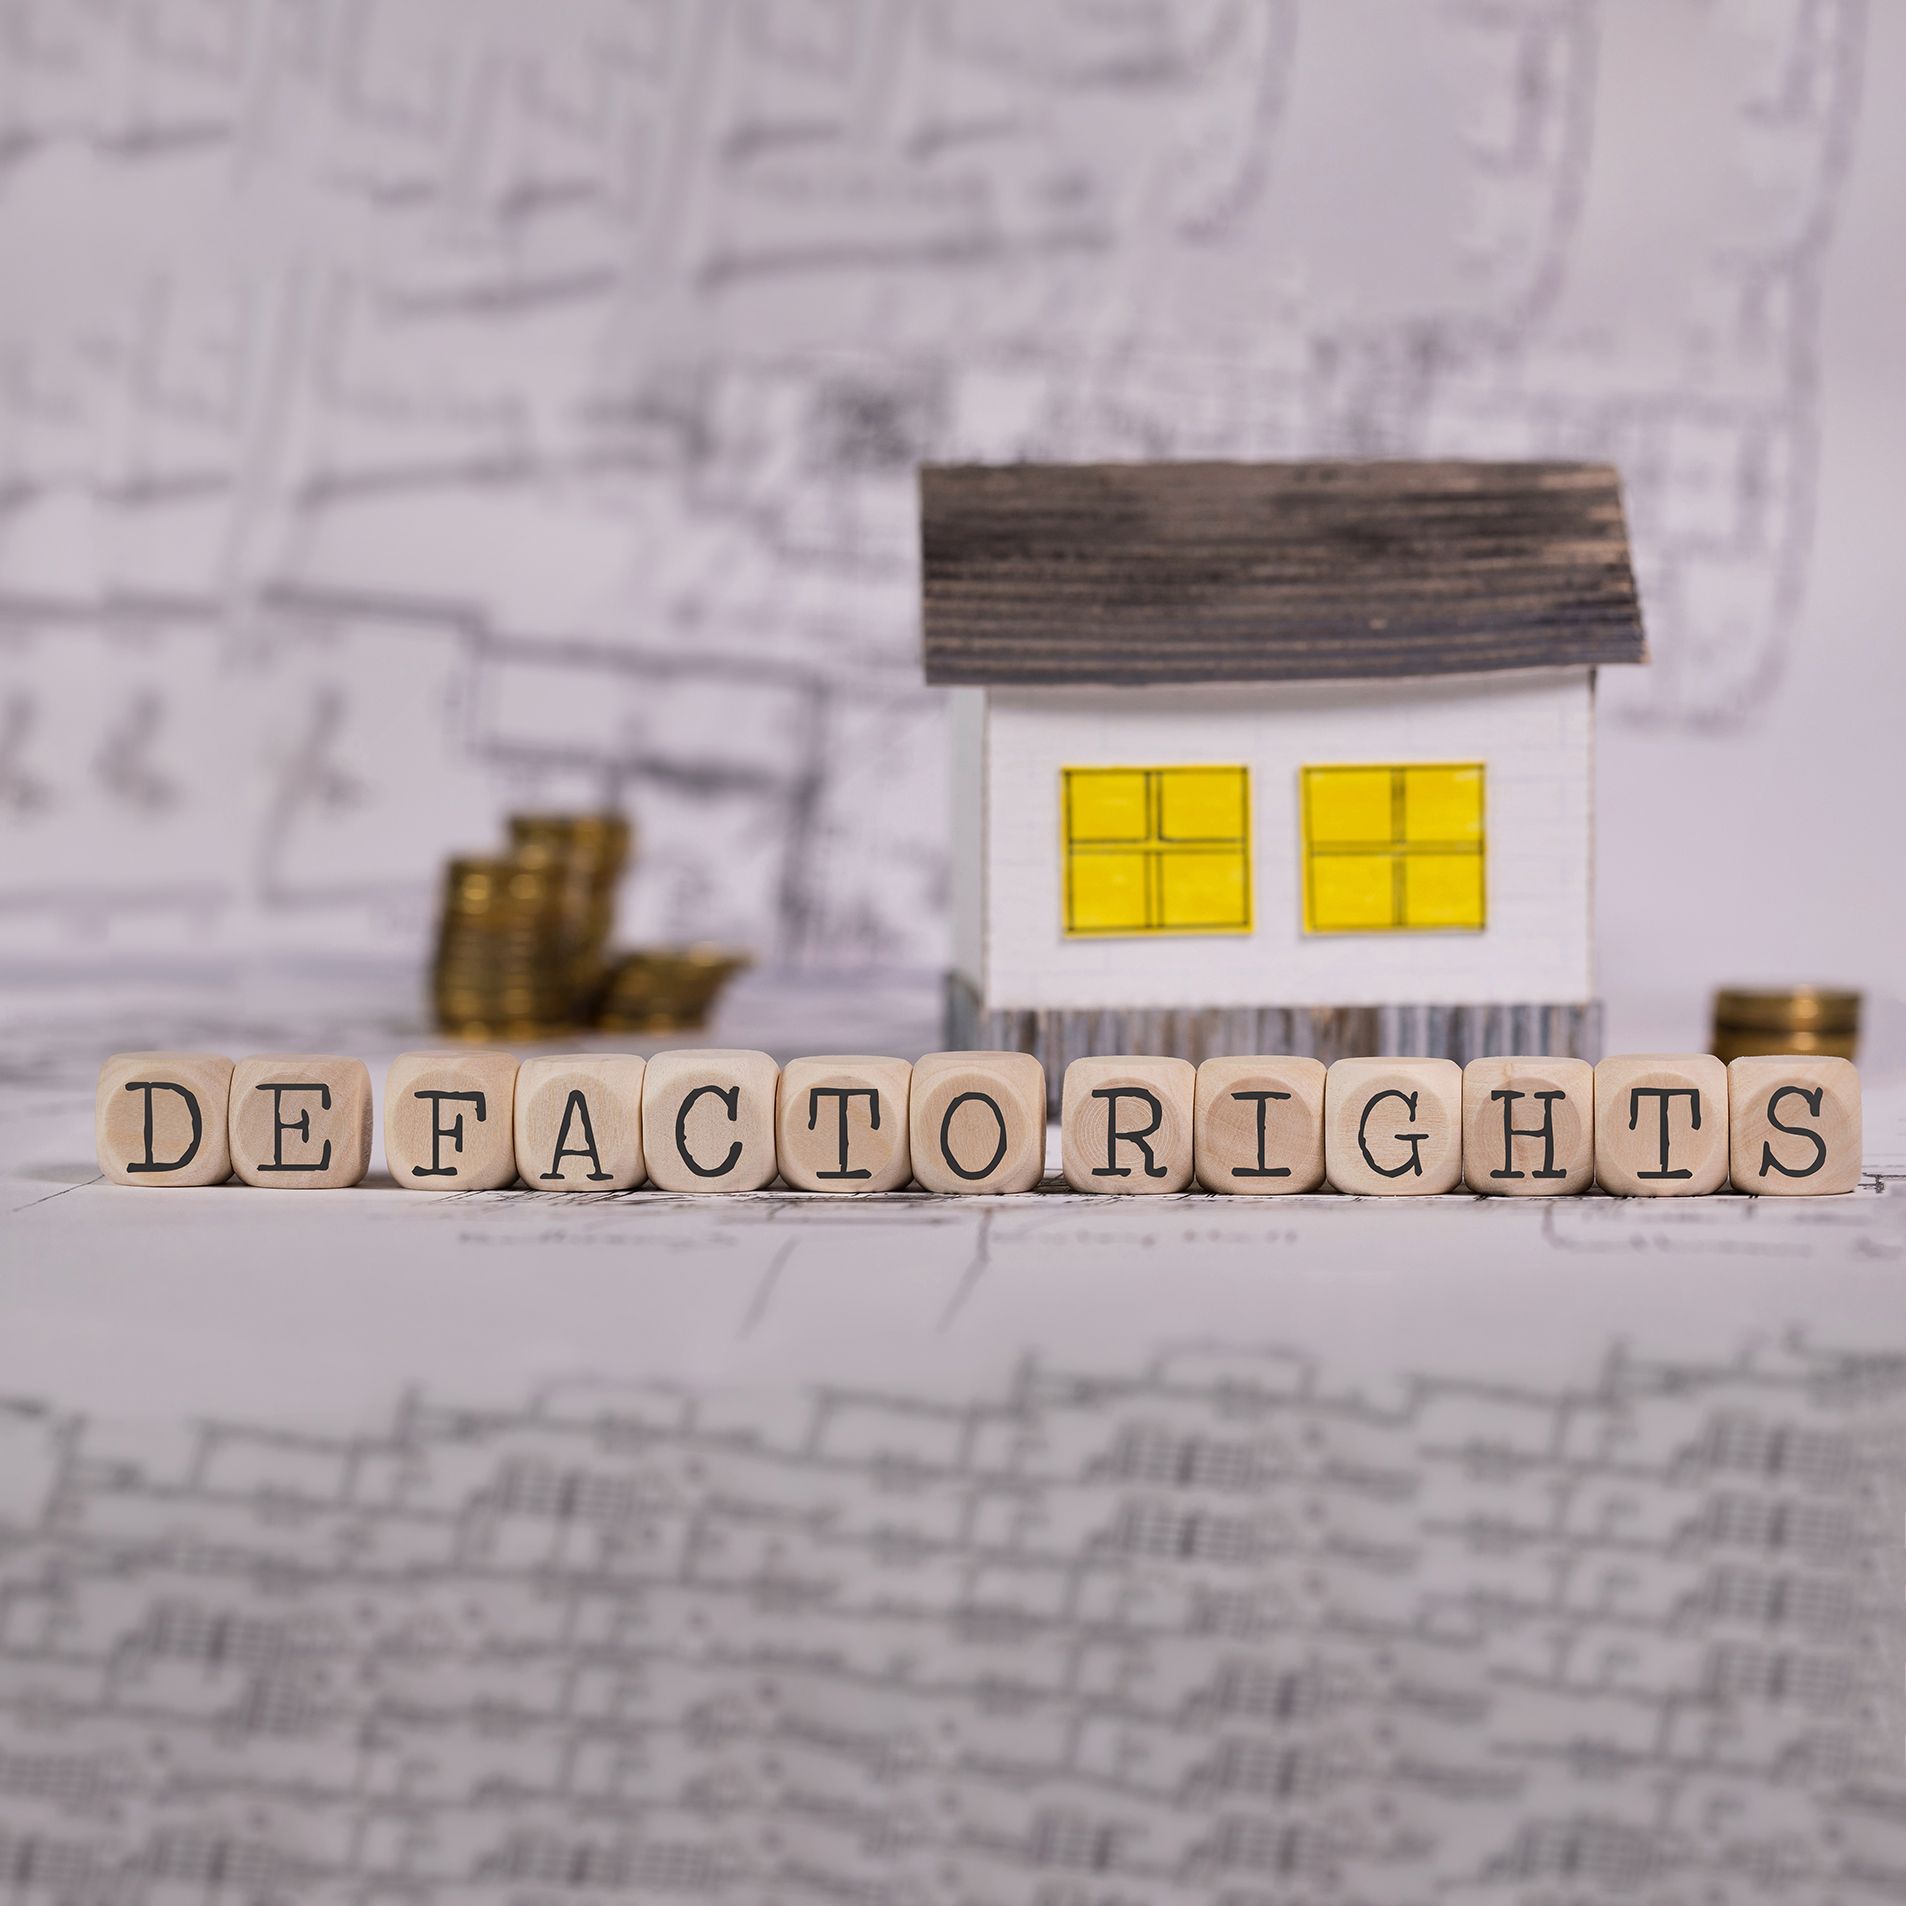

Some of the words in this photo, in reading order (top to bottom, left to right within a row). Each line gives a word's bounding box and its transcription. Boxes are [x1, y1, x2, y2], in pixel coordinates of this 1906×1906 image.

[126, 1081, 332, 1173] DE
[412, 1084, 1008, 1181] FACTO
[1091, 1084, 1828, 1179] RIGHTS
